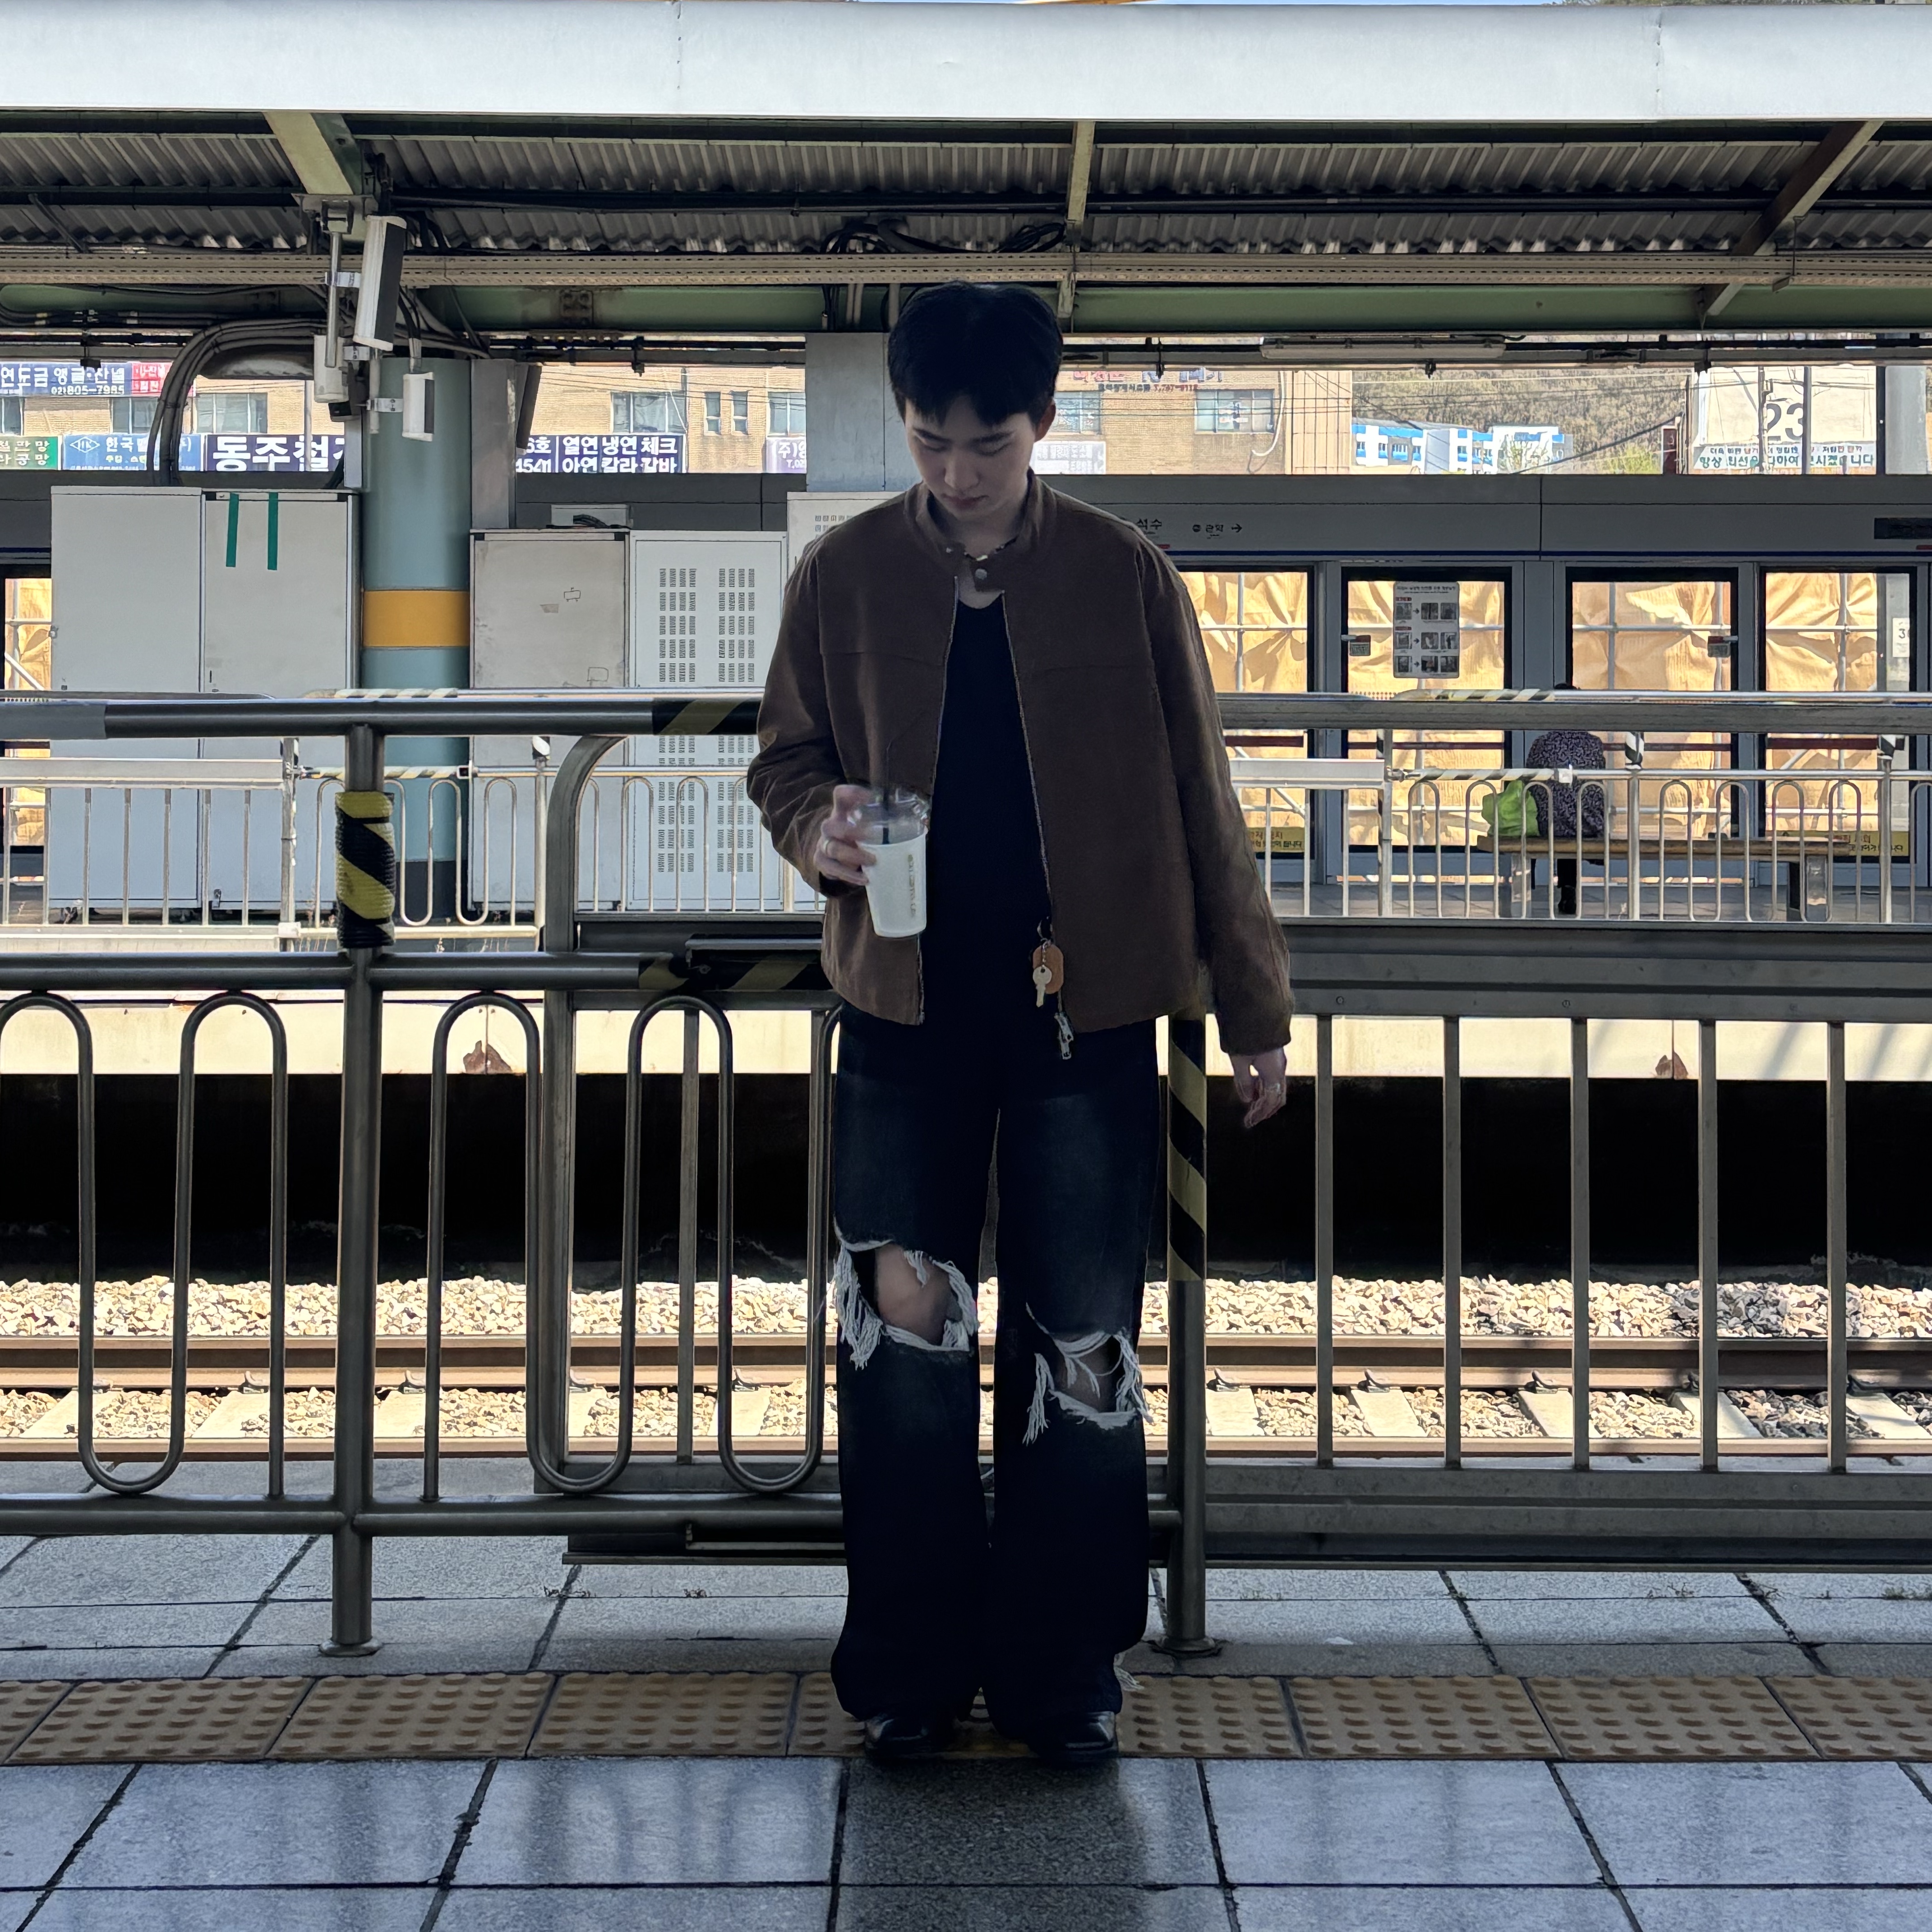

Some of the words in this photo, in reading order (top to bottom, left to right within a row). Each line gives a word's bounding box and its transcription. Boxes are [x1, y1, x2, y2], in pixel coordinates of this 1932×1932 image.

[1766, 402, 1803, 441] 23
[563, 436, 598, 455] 열연
[602, 436, 637, 455] 냉연
[641, 436, 678, 455] 체크
[562, 457, 597, 473] 아연
[1137, 518, 1162, 530] 석수
